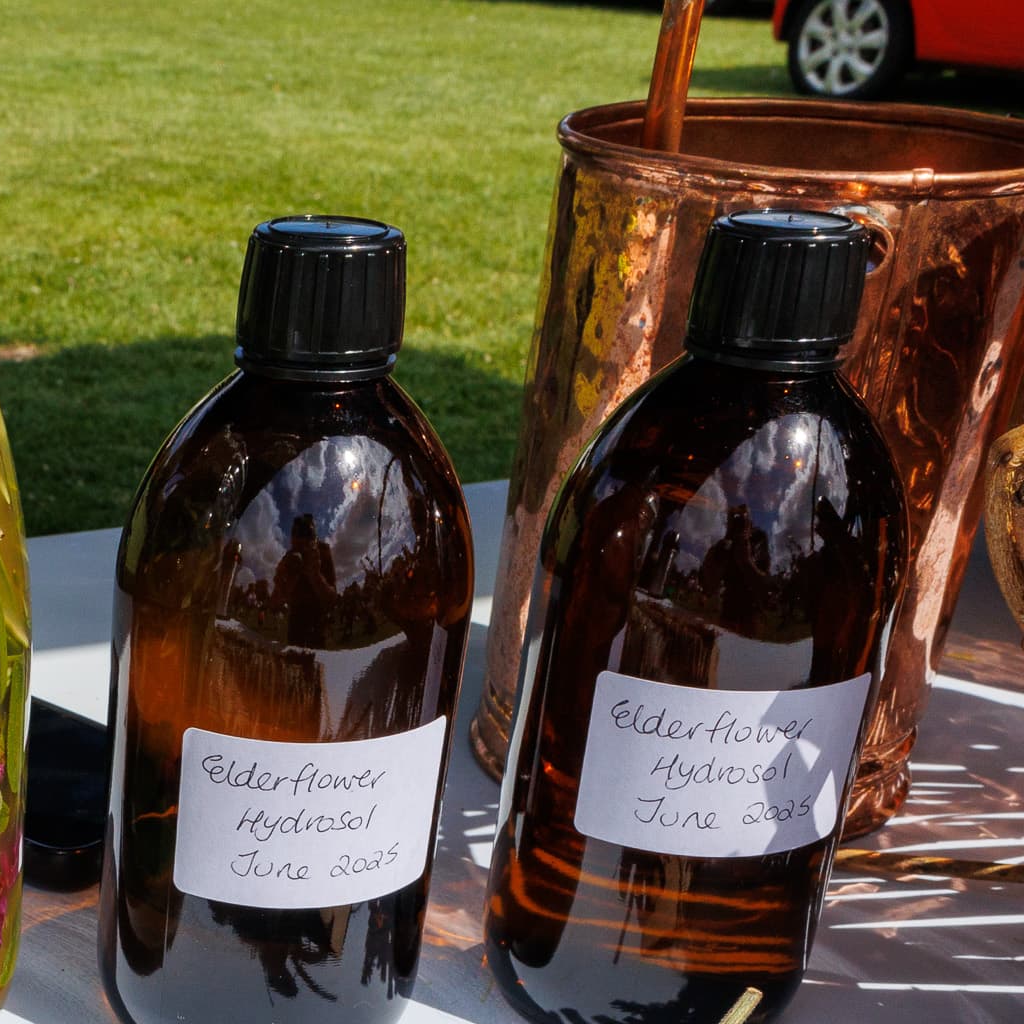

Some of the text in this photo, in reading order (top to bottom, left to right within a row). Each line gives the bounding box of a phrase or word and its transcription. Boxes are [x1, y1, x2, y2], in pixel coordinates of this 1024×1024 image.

[610, 699, 814, 744] Elderflower
[201, 754, 387, 796] Elderflower
[650, 752, 792, 790] Hydrosol
[236, 803, 378, 842] Hydrosol
[633, 794, 812, 830] June 2025
[230, 842, 400, 881] June 2025
